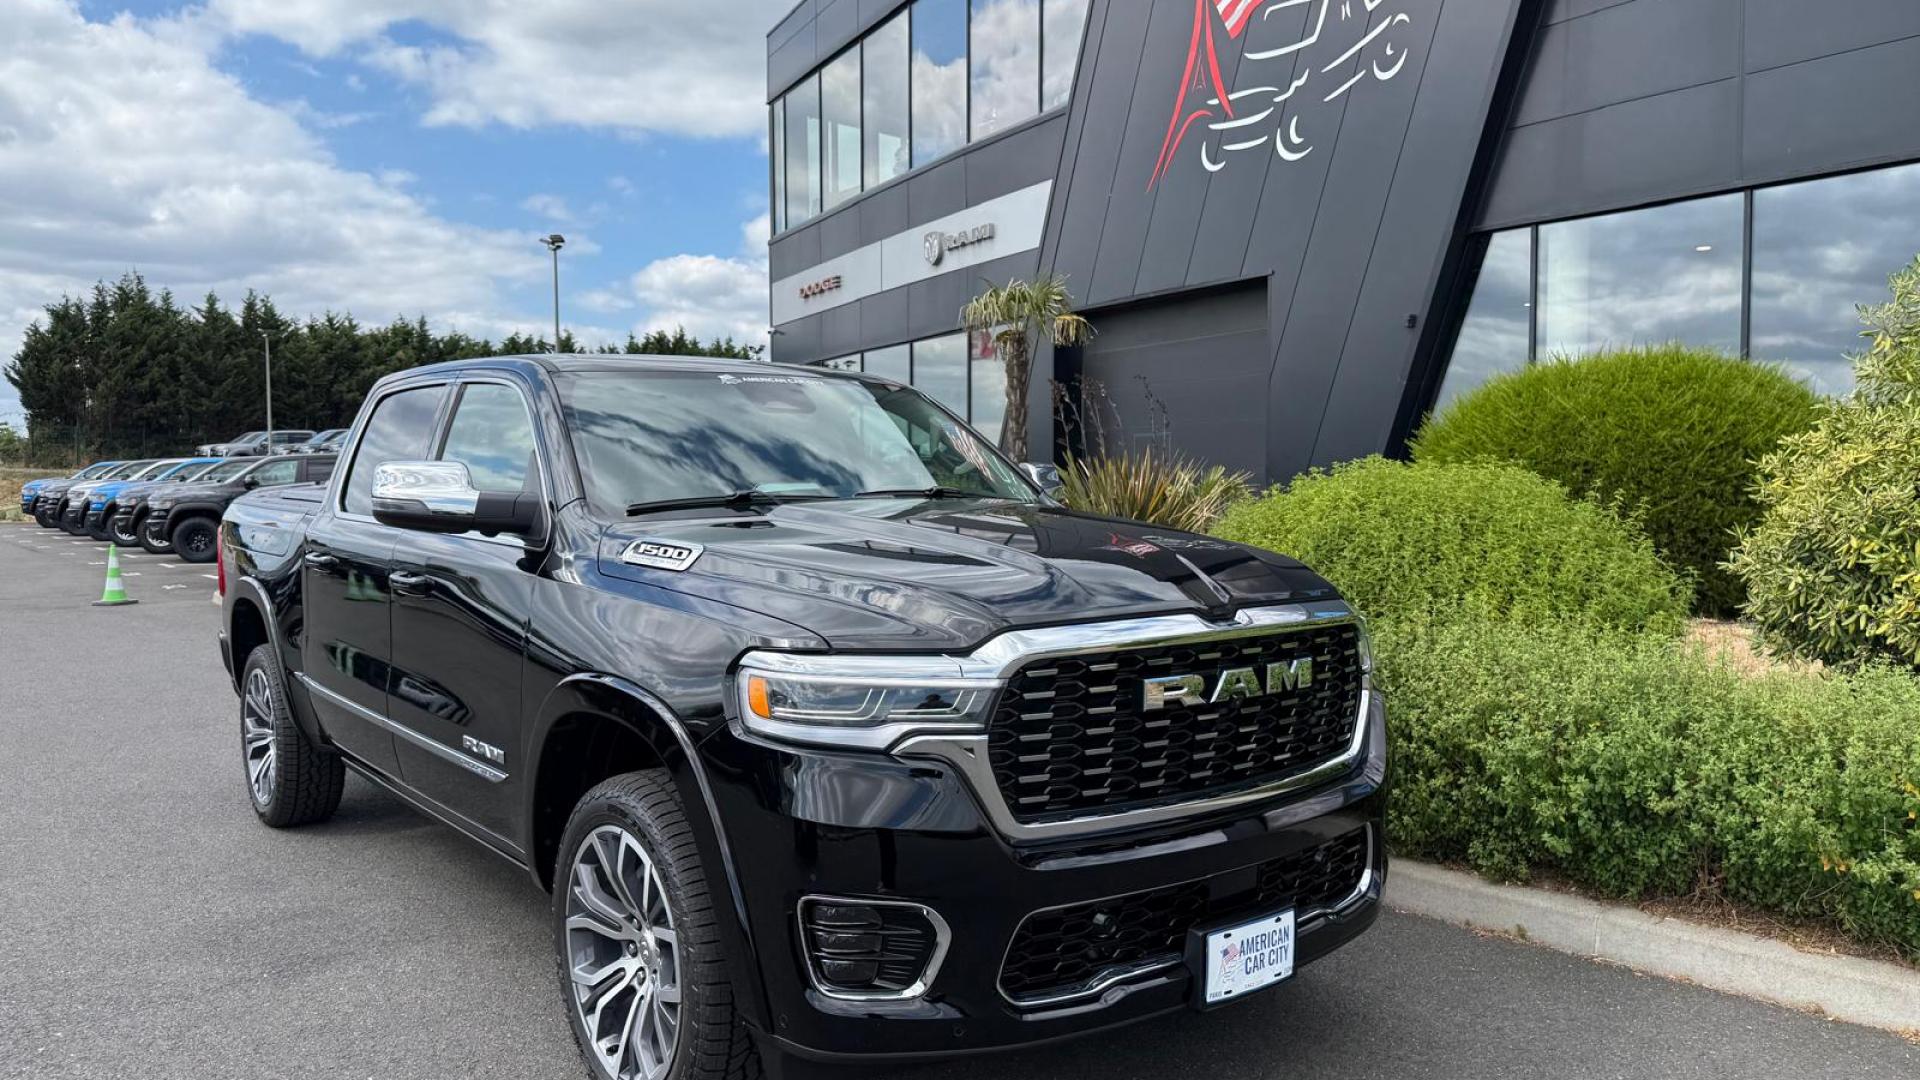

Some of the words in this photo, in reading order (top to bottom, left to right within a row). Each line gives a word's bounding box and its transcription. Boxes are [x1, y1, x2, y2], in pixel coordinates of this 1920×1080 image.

[943, 223, 995, 251] RAM
[799, 275, 841, 299] DODGE
[638, 543, 689, 560] 1500
[1143, 656, 1313, 712] RAM
[462, 734, 505, 765] RAM
[1240, 925, 1290, 957] AMERICAN
[1244, 952, 1266, 975] CAR
[1268, 943, 1289, 966] CITY
